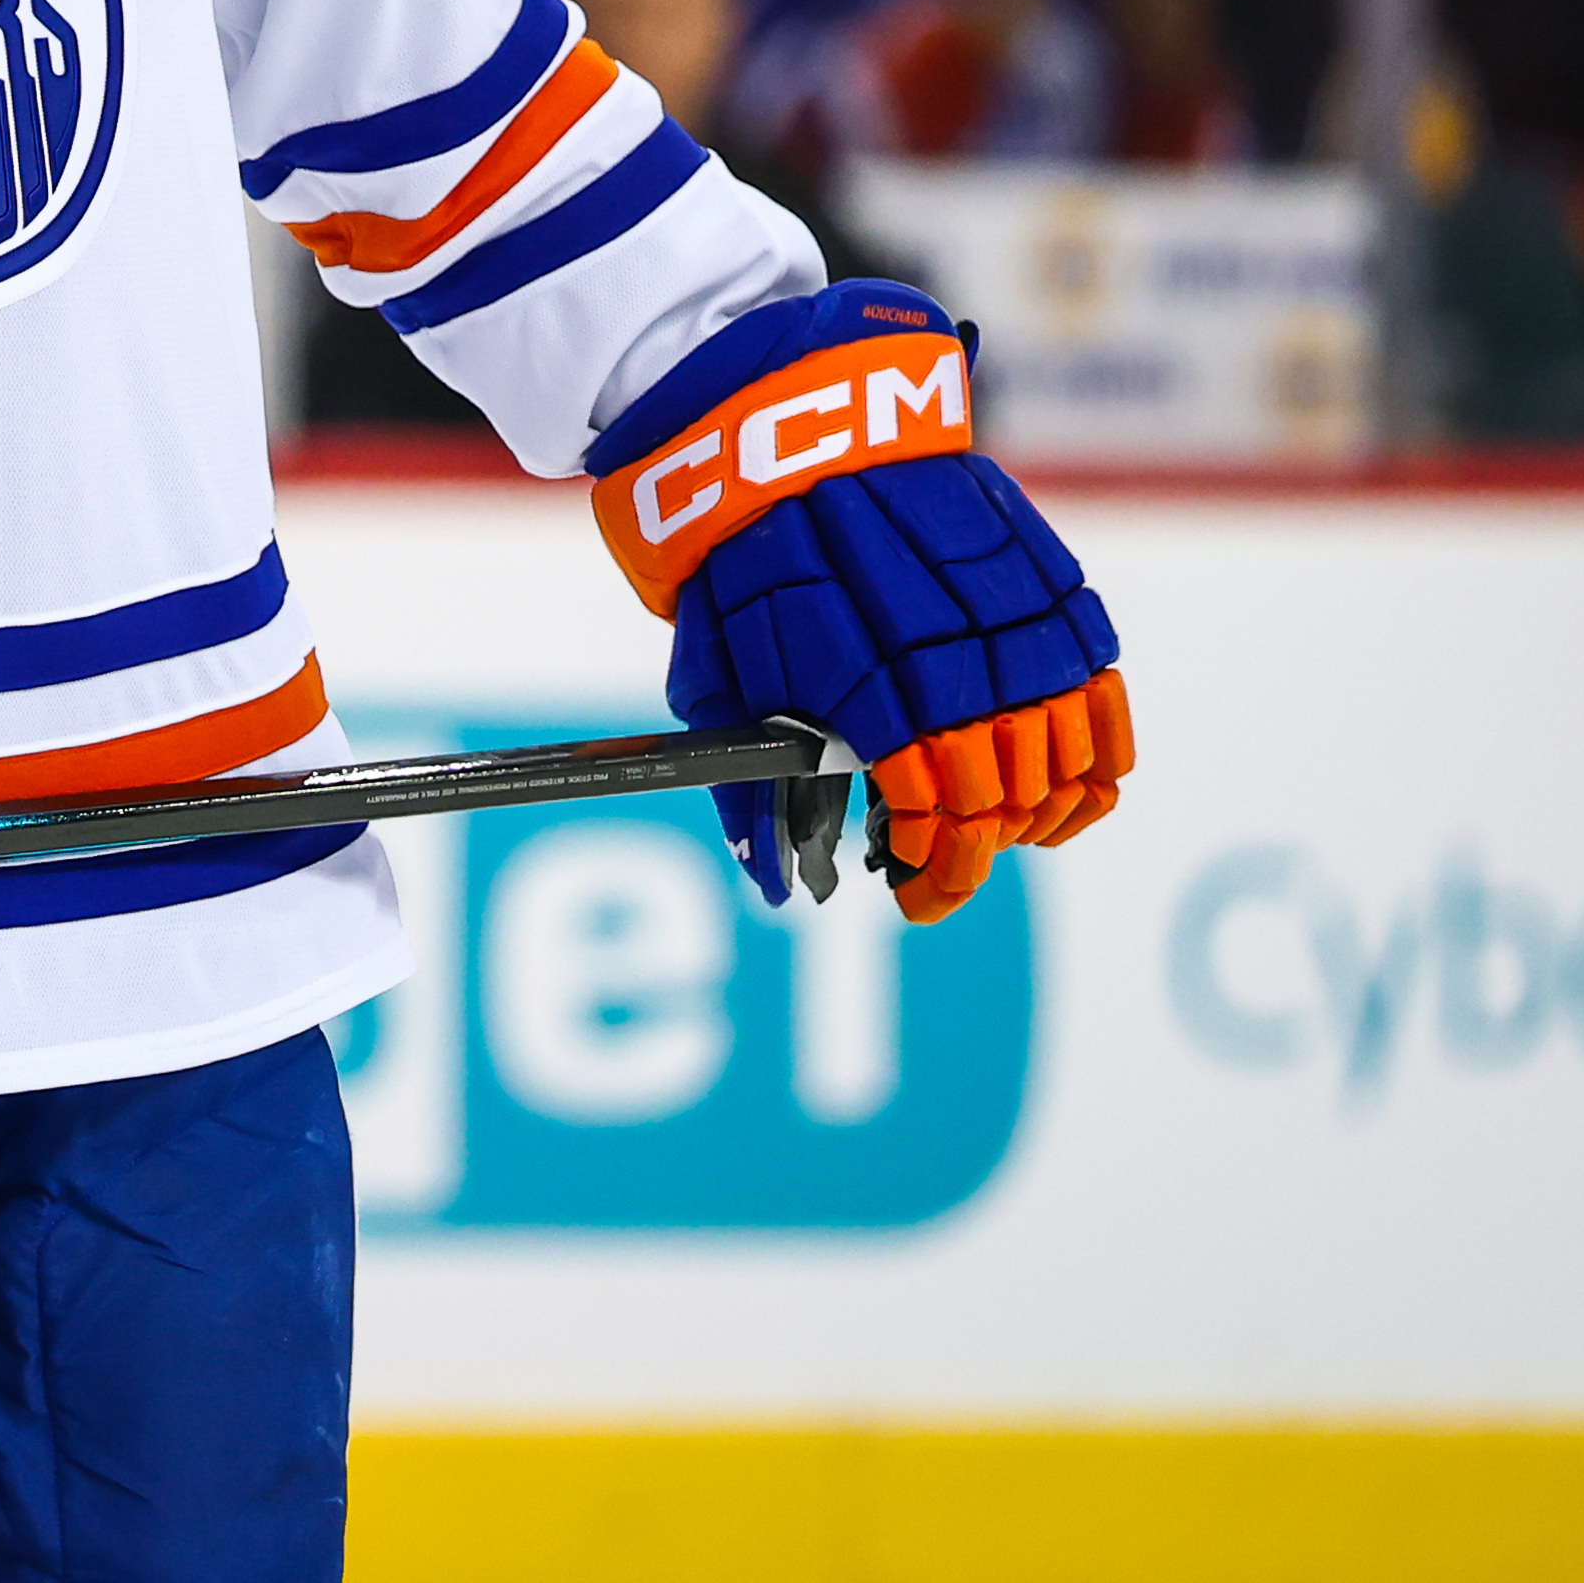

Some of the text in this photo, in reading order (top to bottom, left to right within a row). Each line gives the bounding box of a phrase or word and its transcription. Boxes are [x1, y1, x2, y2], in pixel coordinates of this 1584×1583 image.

[863, 305, 928, 327] BOUCHARD
[632, 351, 966, 546] CCM
[1158, 836, 1584, 1124] Cyb
